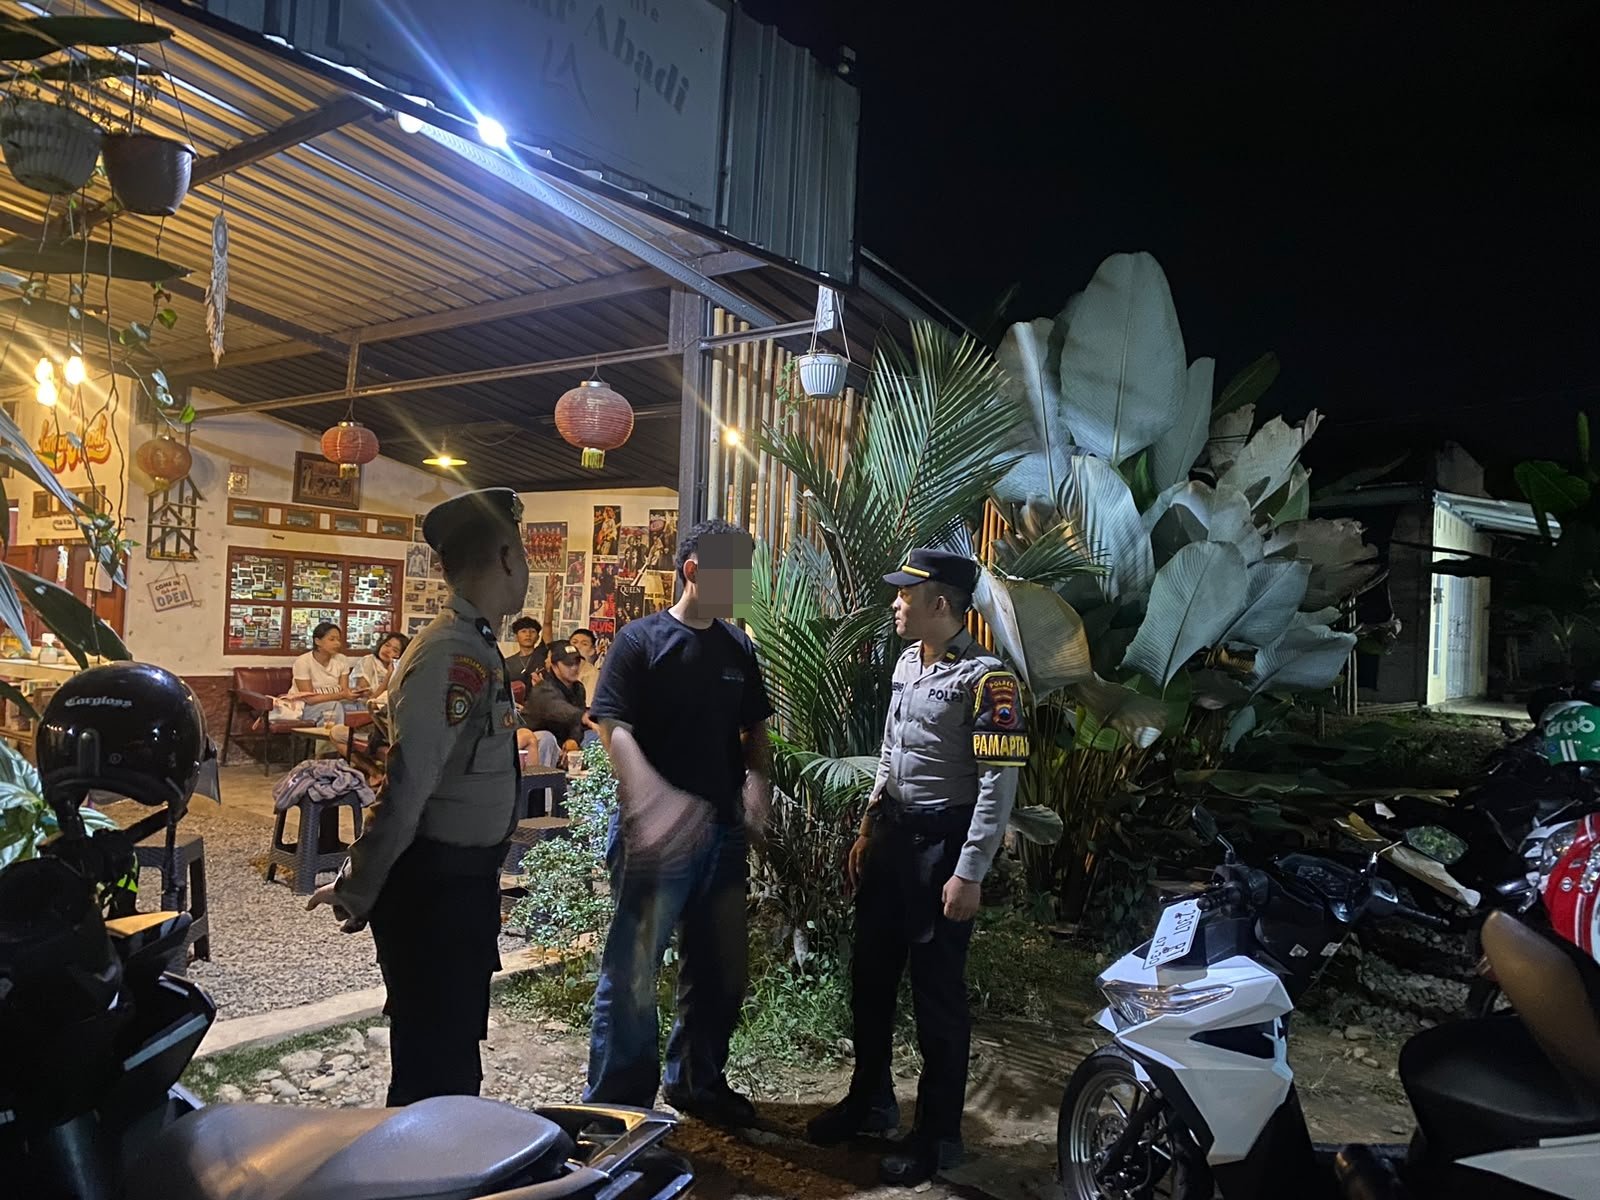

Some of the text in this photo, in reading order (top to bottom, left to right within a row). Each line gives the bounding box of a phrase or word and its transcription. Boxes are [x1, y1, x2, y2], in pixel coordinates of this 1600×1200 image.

[584, 3, 690, 115] Abadi
[155, 581, 172, 591] COME
[620, 585, 641, 597] QUEEN
[156, 590, 189, 607] OPEN
[589, 620, 614, 633] ELVIS
[64, 695, 134, 709] Cargloss
[1545, 715, 1596, 737] Grab
